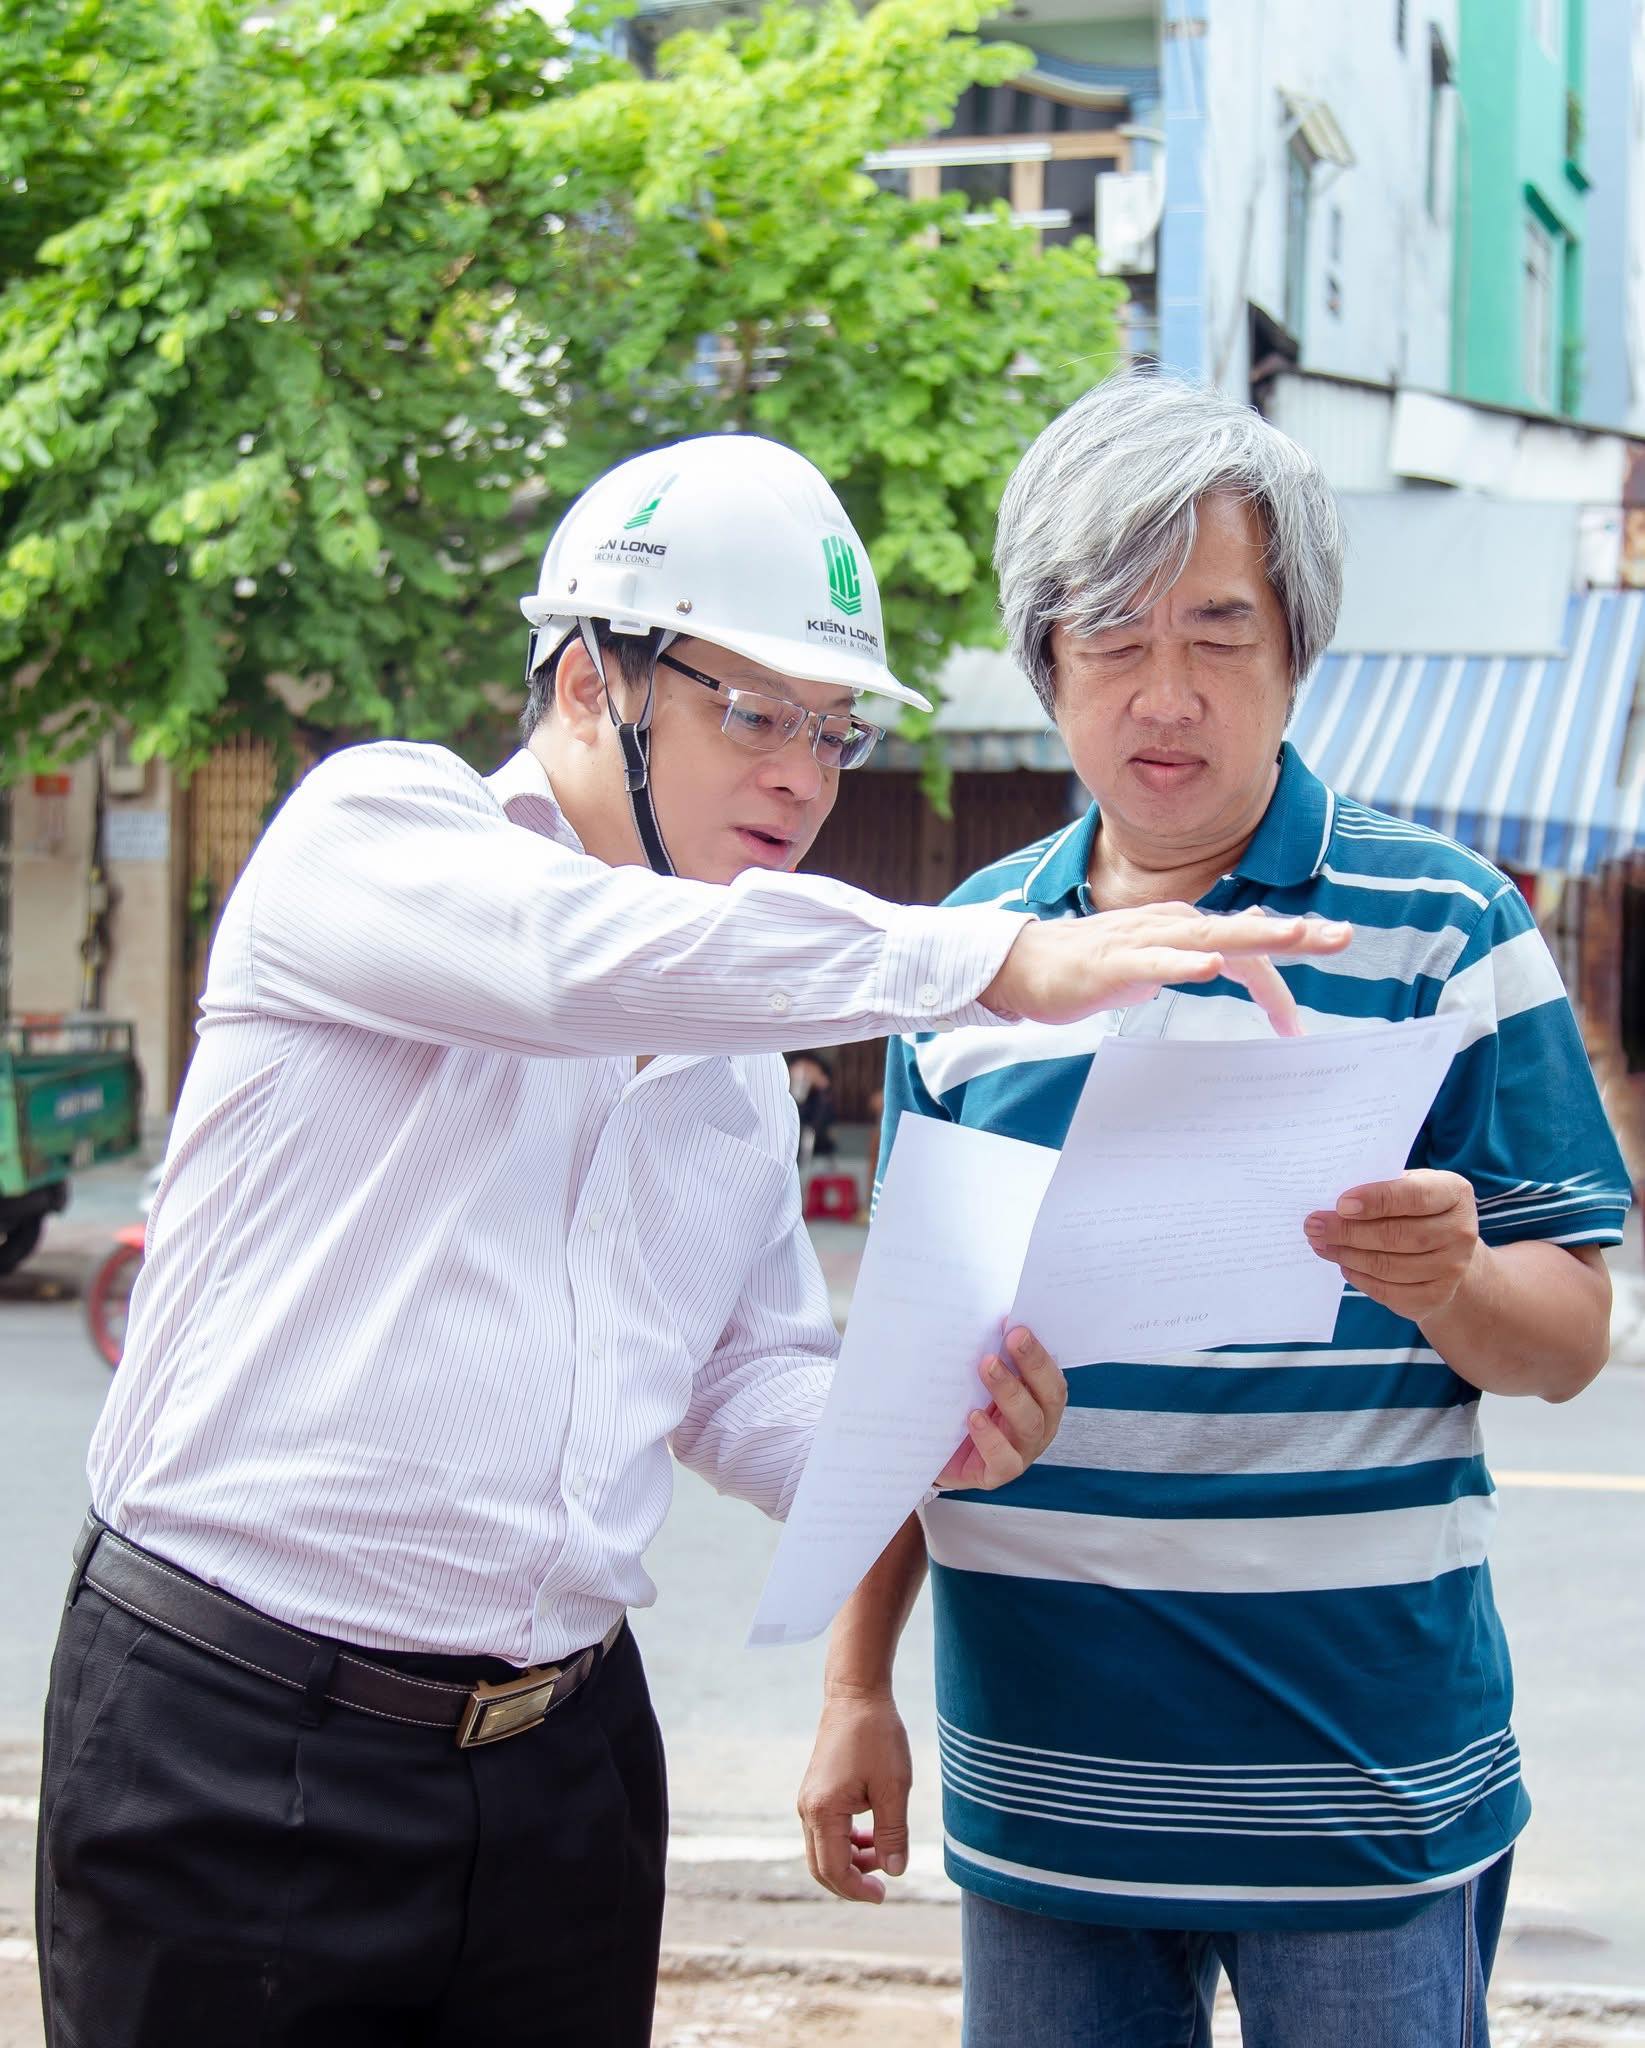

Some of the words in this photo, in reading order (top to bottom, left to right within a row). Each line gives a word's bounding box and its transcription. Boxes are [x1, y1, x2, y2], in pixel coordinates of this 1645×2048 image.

[620, 540, 667, 556] LONG
[625, 554, 650, 565] CONS
[822, 634, 847, 647] ARCH
[849, 626, 879, 648] LONG
